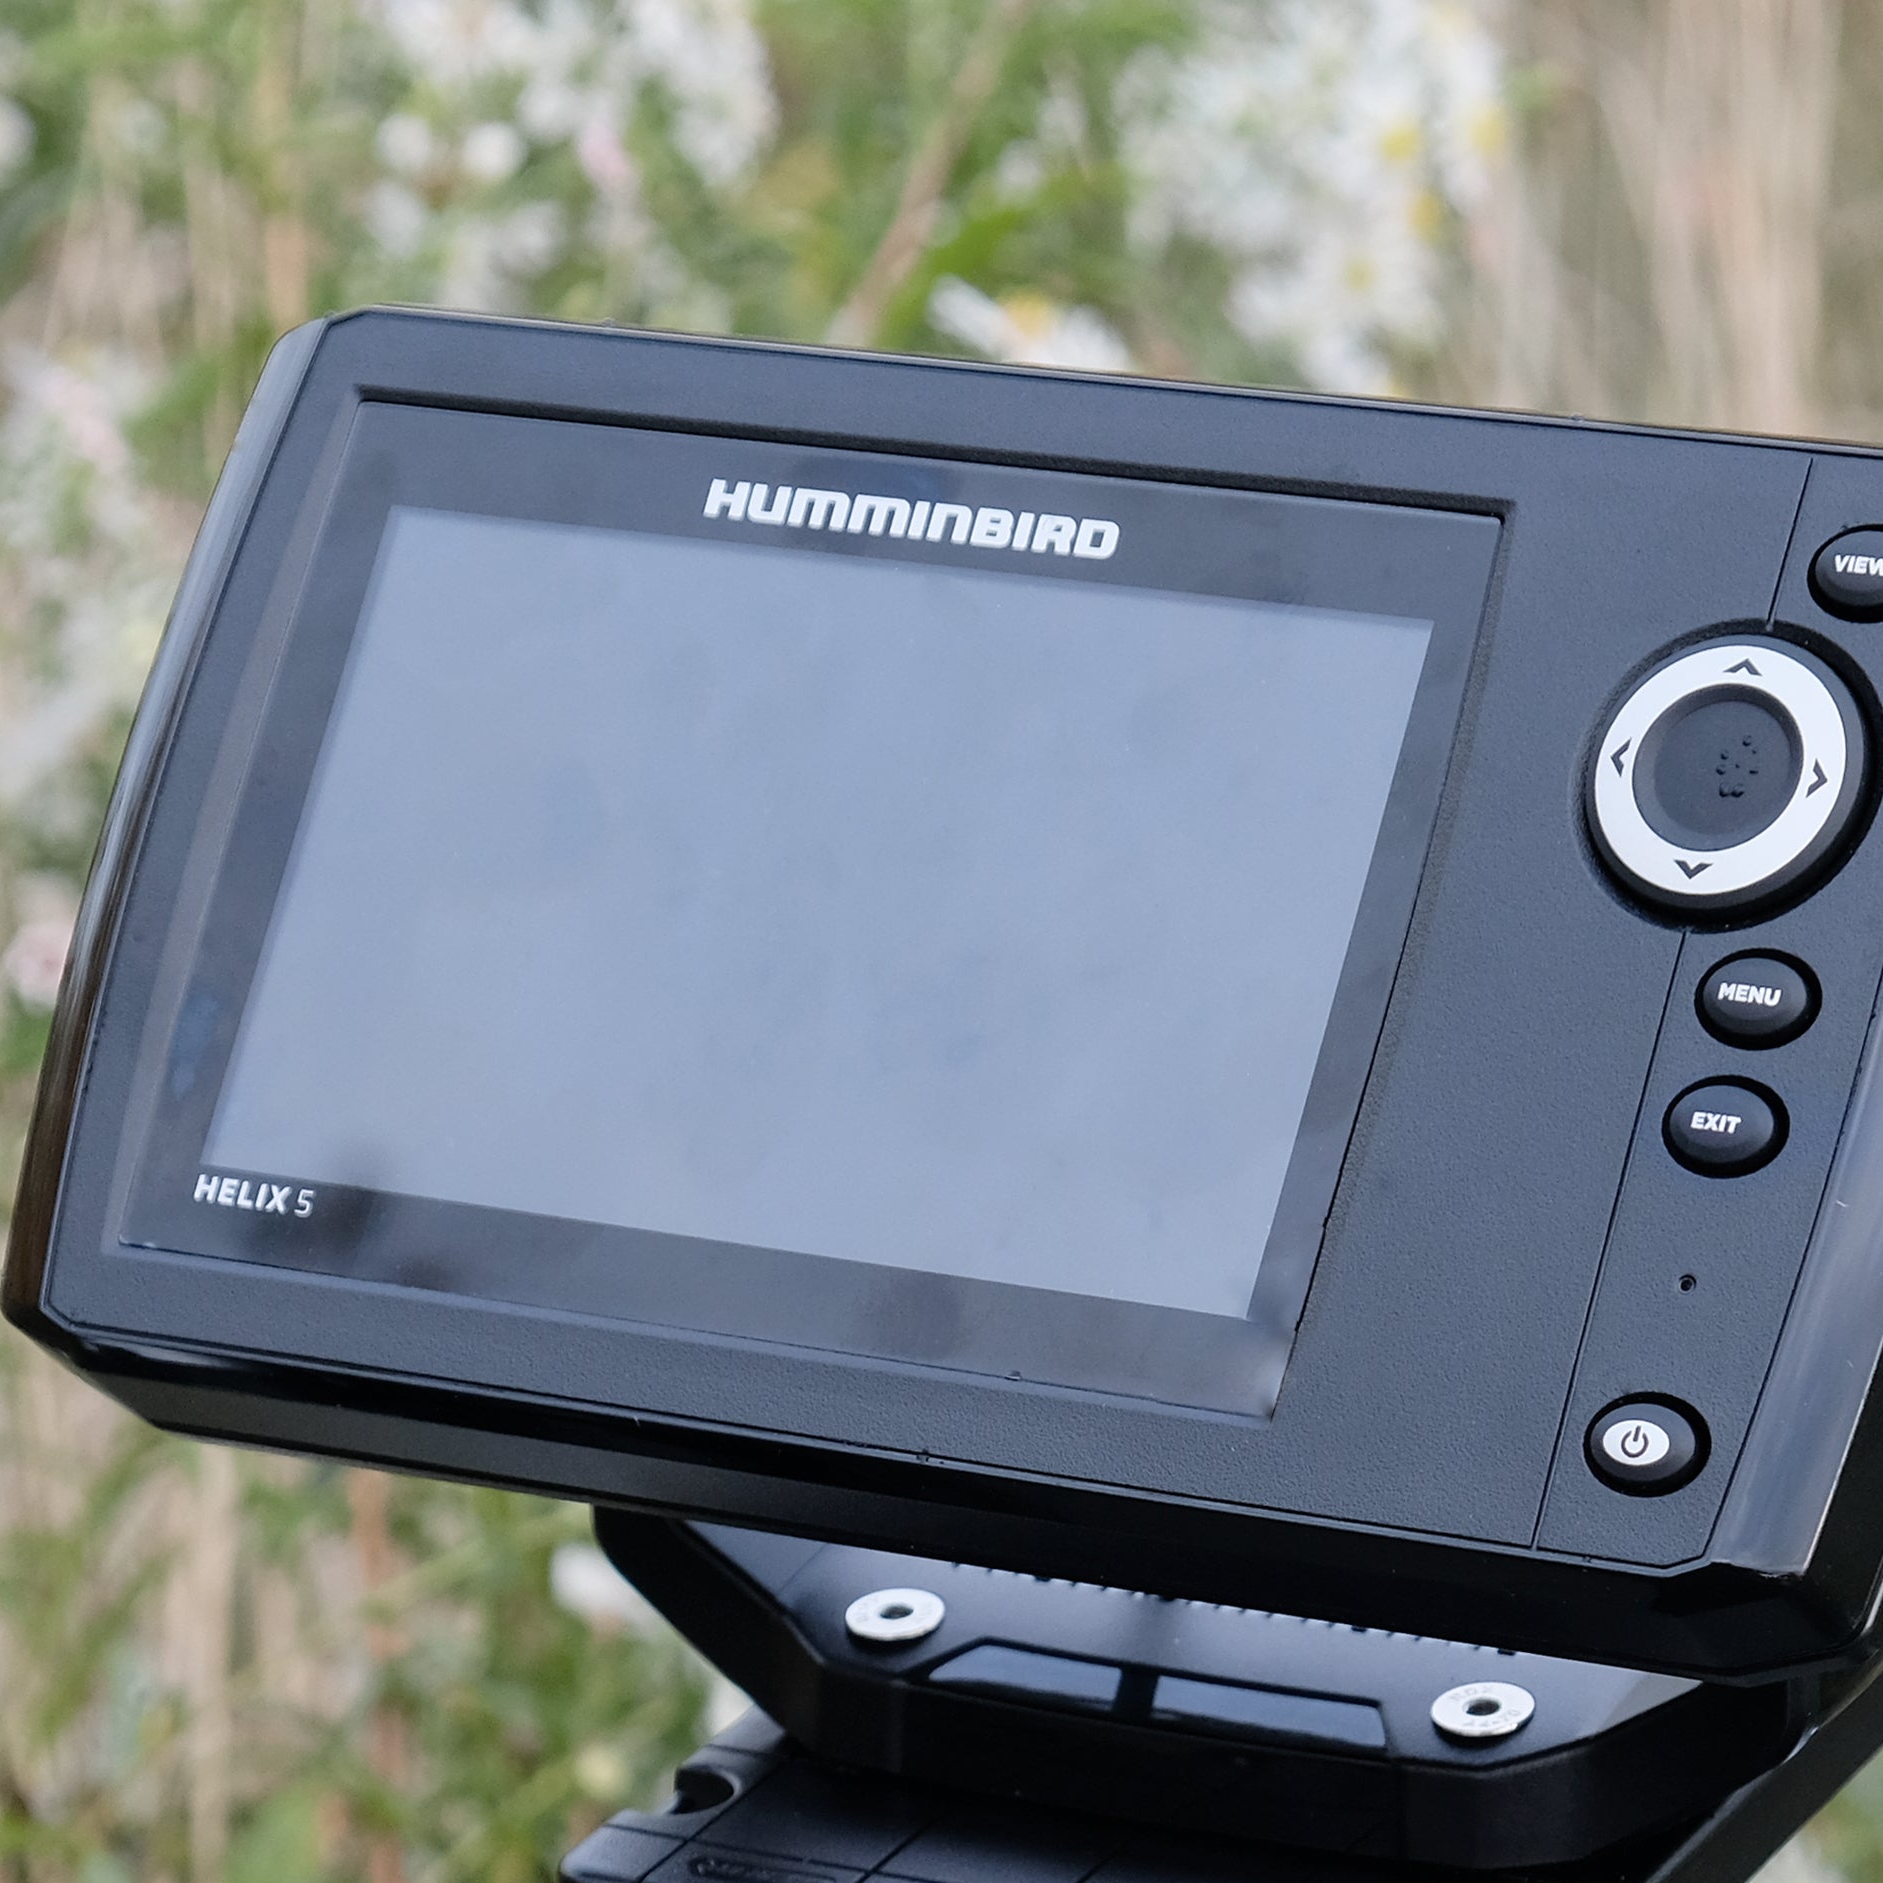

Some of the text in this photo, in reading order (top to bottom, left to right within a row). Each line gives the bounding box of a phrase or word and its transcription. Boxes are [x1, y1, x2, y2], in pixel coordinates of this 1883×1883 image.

[703, 477, 1120, 560] HUMMINBIRD
[1717, 981, 1782, 1008] MENU
[1690, 1110, 1742, 1134] EXIT
[193, 1173, 316, 1218] HELIX 5
